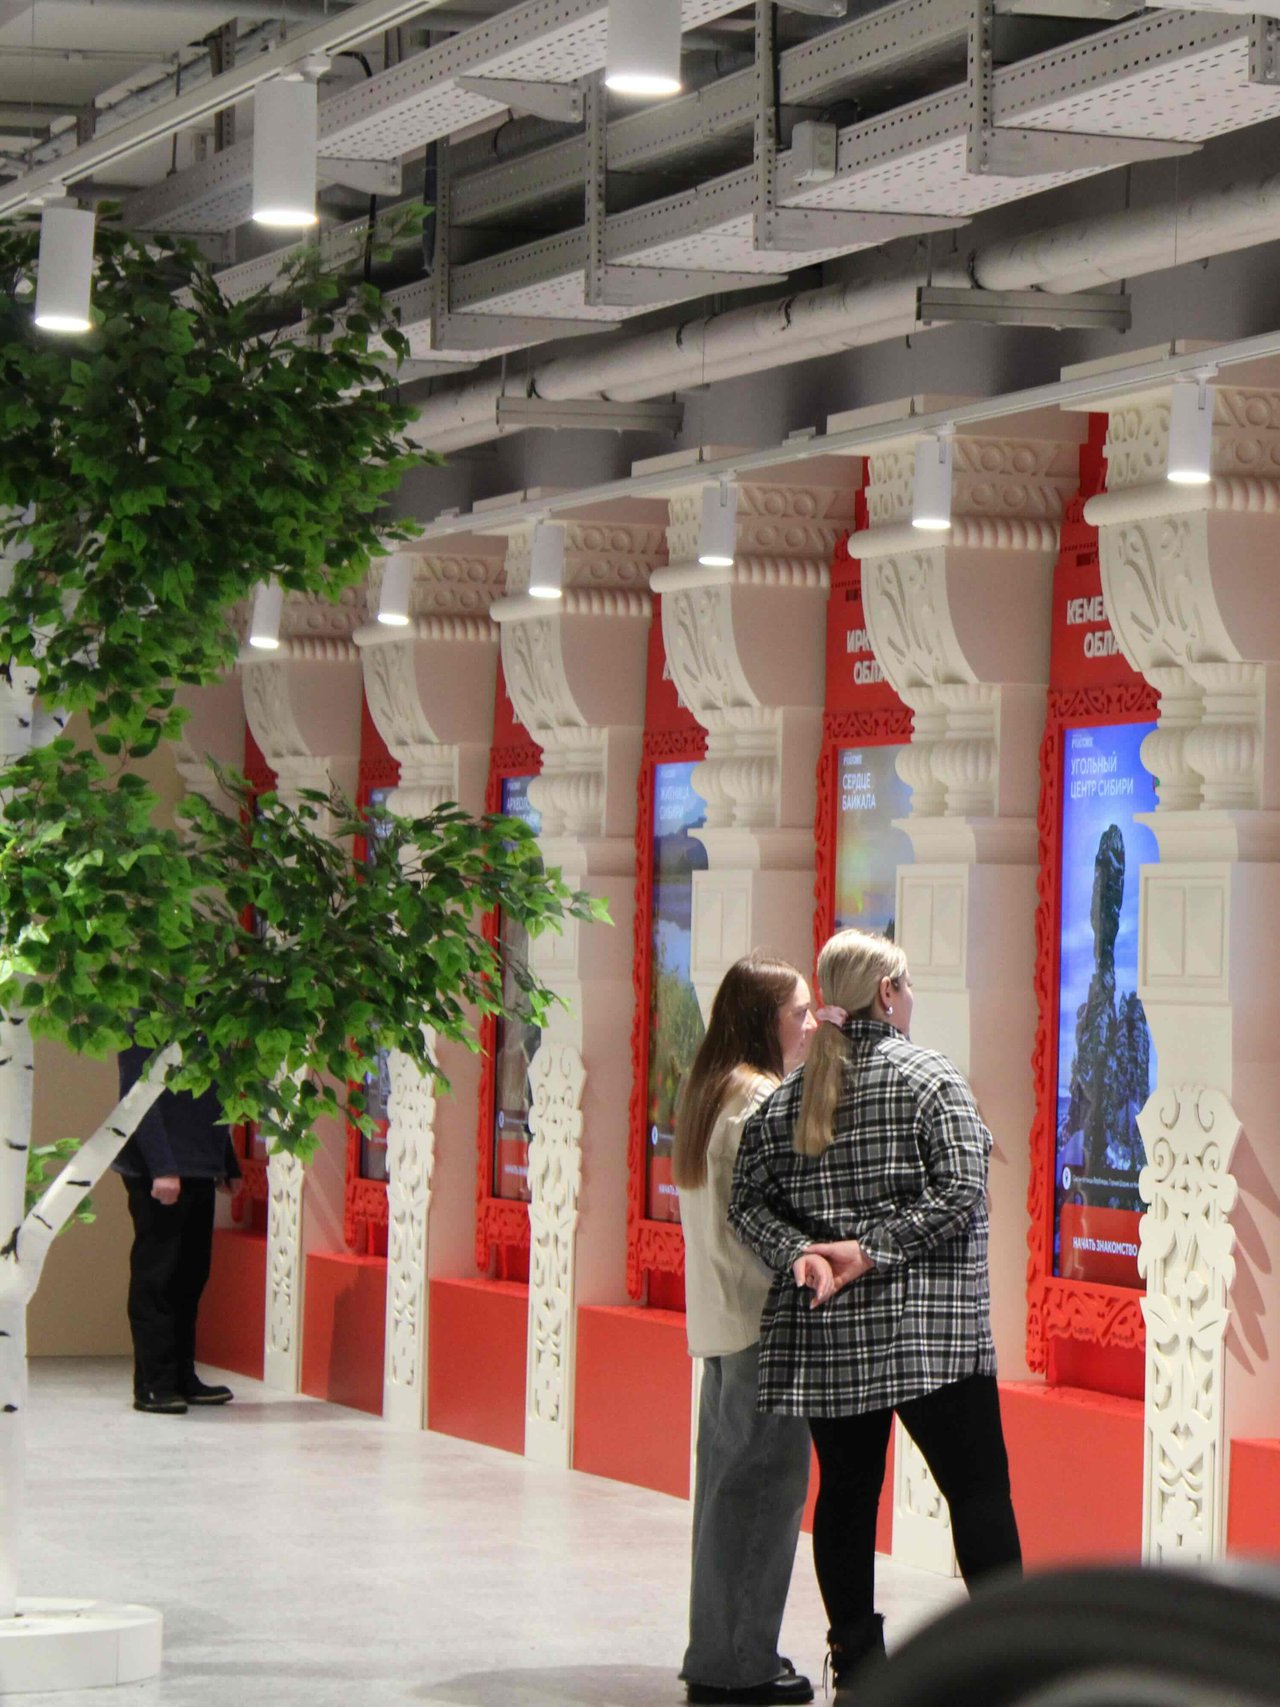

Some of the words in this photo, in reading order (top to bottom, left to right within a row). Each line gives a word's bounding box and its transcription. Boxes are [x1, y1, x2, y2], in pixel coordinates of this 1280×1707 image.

[1066, 596, 1108, 625] КЕМЕ
[1071, 750, 1118, 776] УГОЛЬНЫЙ
[842, 772, 871, 790] СЕРДЦЕ
[1071, 779, 1096, 800] ЦЕНТР
[1098, 777, 1134, 797] СИБИРИ
[1073, 1236, 1096, 1252] НАЧАТЬ
[1096, 1239, 1138, 1257] ЗНАКОМСТВО
